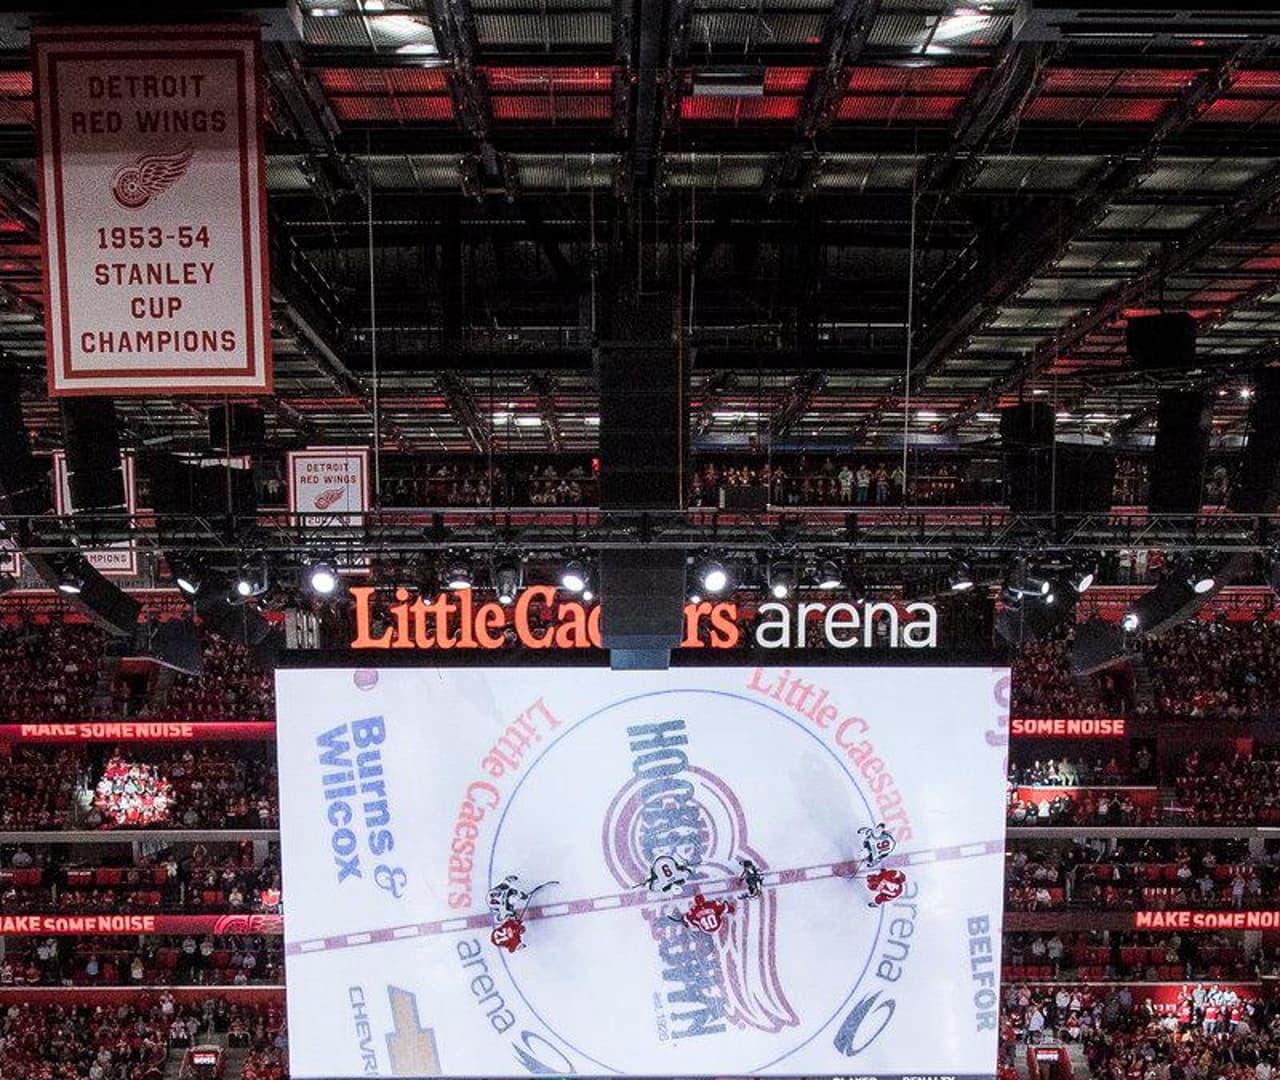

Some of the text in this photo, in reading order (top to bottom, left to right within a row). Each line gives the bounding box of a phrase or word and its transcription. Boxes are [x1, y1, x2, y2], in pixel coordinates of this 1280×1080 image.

[88, 75, 205, 99] DETROIT
[71, 110, 227, 134] RED WINGS
[97, 226, 210, 249] 1953-54
[95, 262, 215, 286] STANLEY
[130, 296, 182, 319] CUP
[80, 330, 236, 353] CHAMPIONS
[349, 585, 506, 649] Little
[755, 600, 938, 648] arena
[1012, 719, 1125, 735] SOME NOISE
[351, 715, 394, 856] Burns
[835, 717, 915, 845] Caesars
[316, 723, 363, 884] Wilcox
[448, 697, 562, 909] Little Caesars
[44, 918, 97, 931] SOME
[98, 915, 155, 931] NOISE
[1136, 911, 1191, 929] MAKE
[1195, 913, 1245, 929] SOME
[967, 914, 997, 1033] BELFOR
